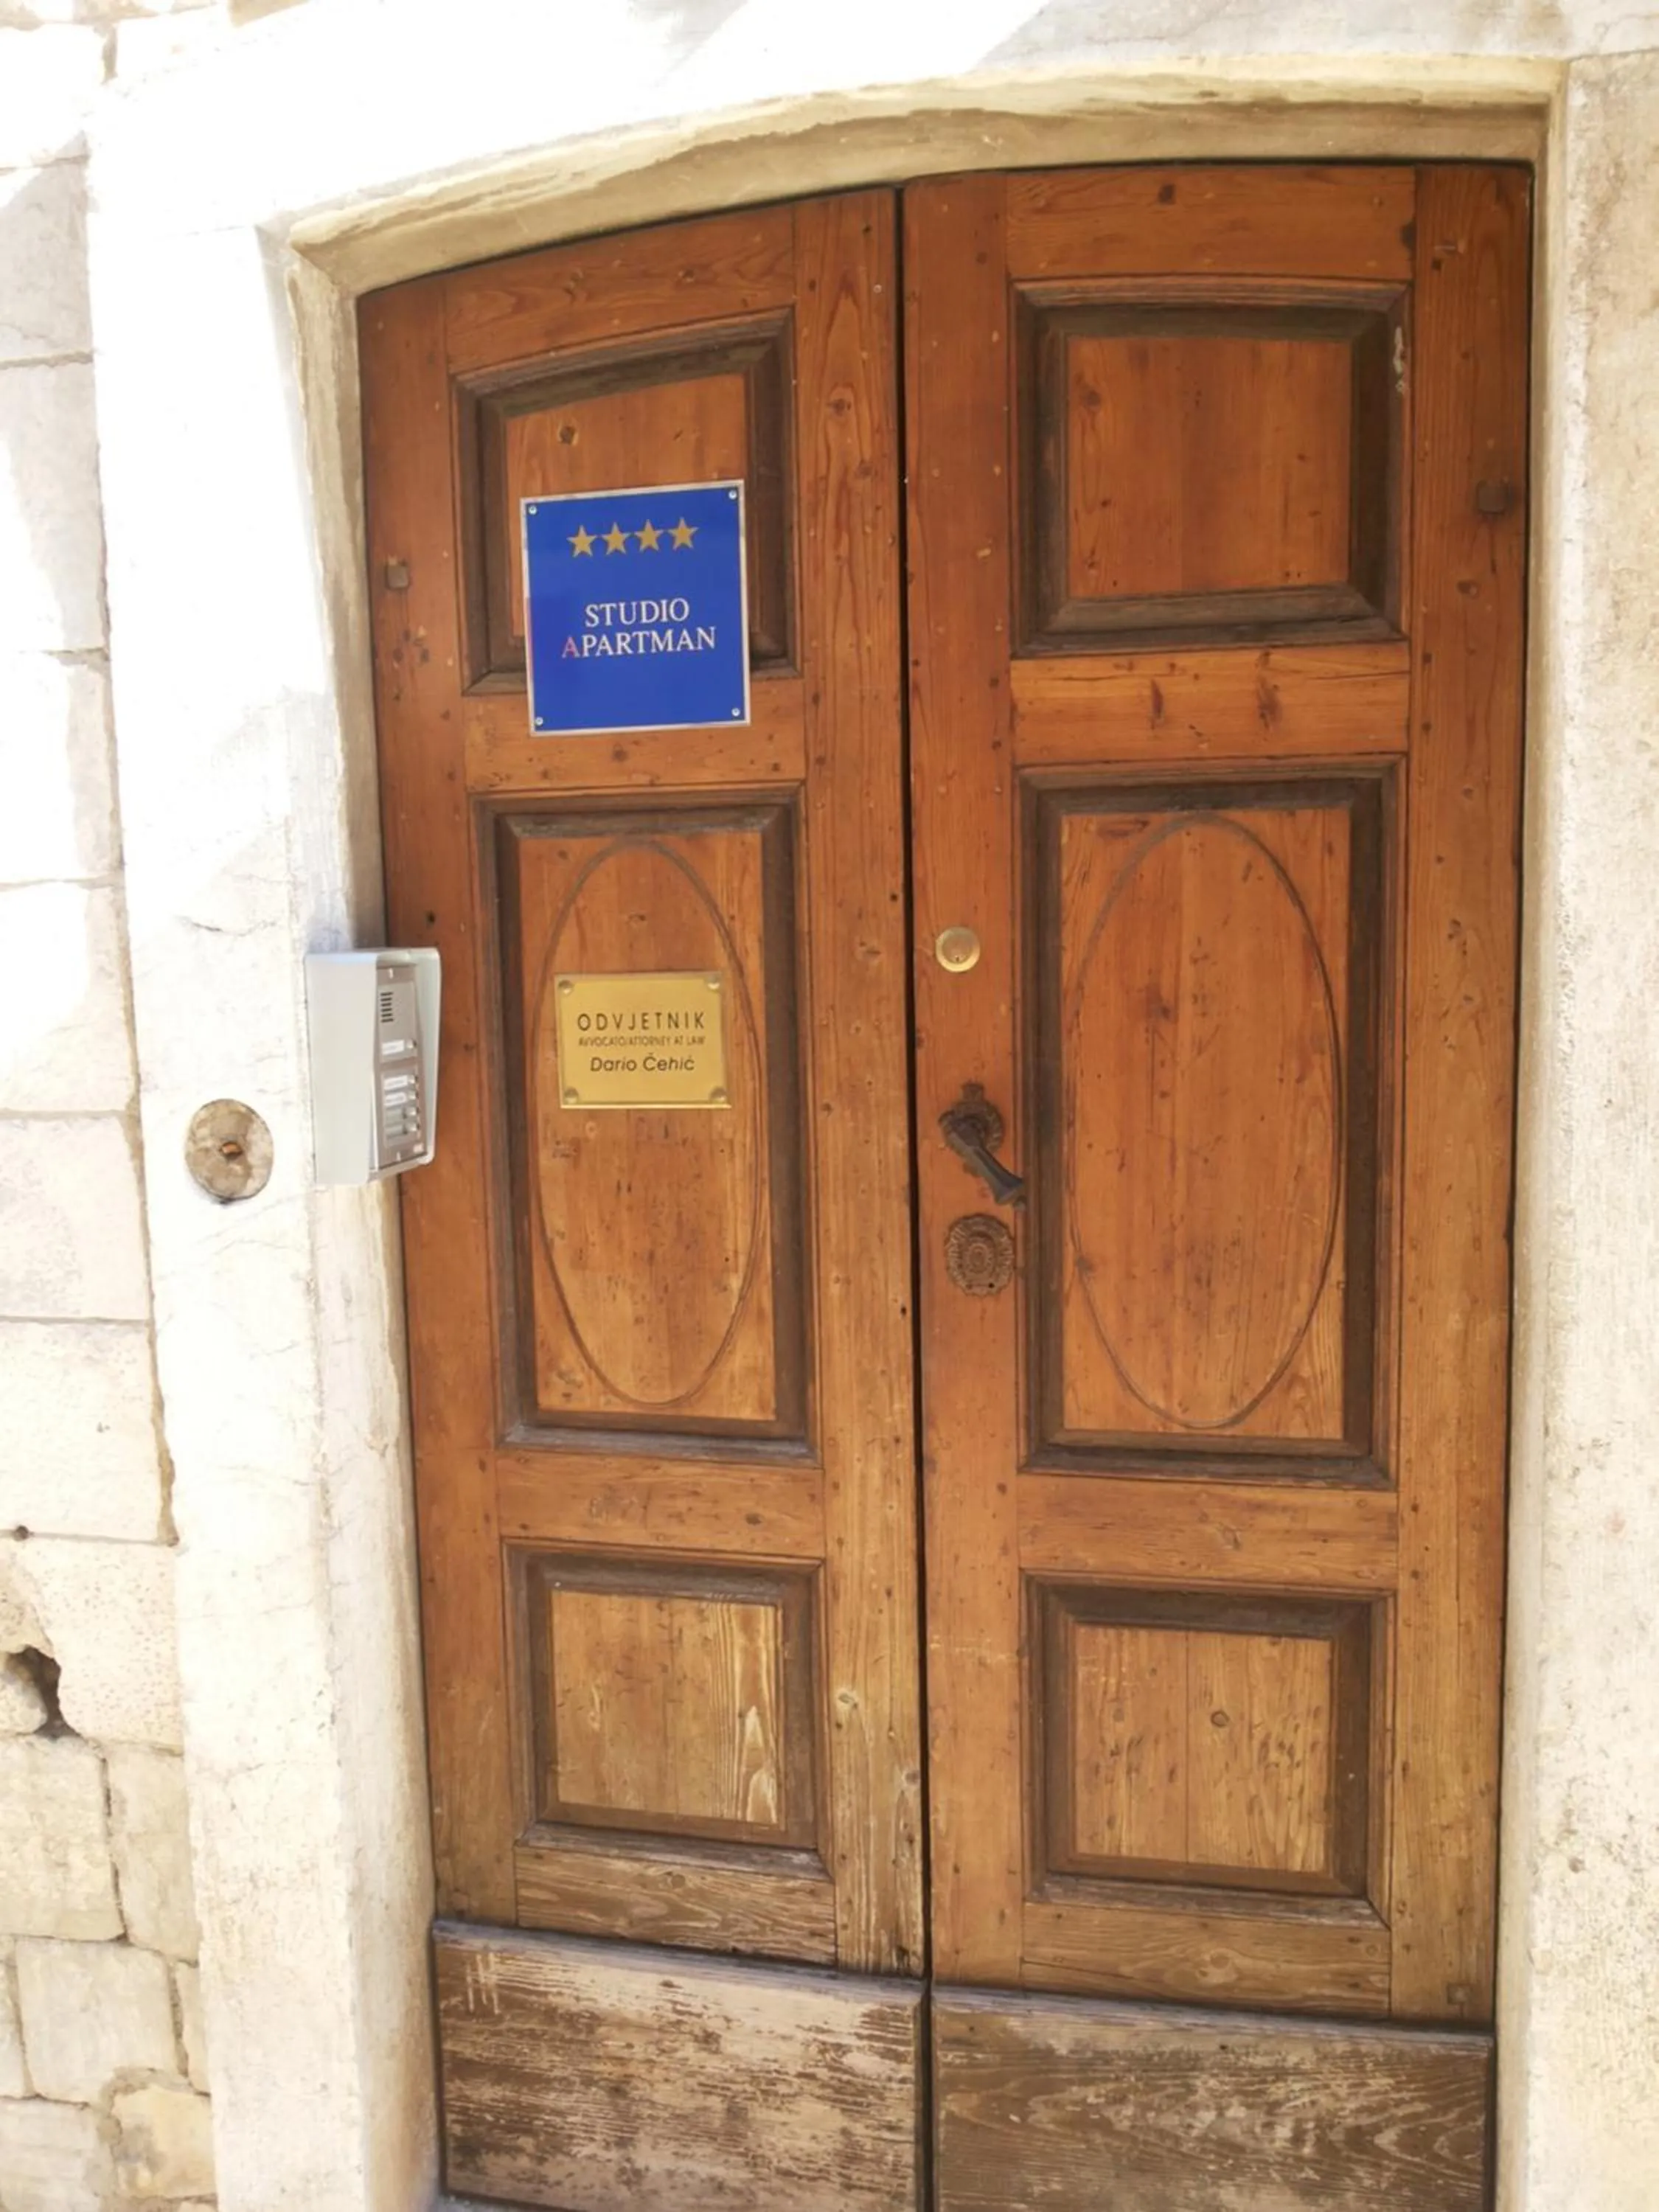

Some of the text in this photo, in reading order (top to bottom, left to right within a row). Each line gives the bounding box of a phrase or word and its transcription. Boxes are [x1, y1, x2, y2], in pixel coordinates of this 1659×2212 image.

[585, 597, 690, 627] STUDIO
[562, 626, 717, 658] APARTMAN
[577, 1012, 705, 1032] ODVJETNIK
[590, 1056, 638, 1072] Dario
